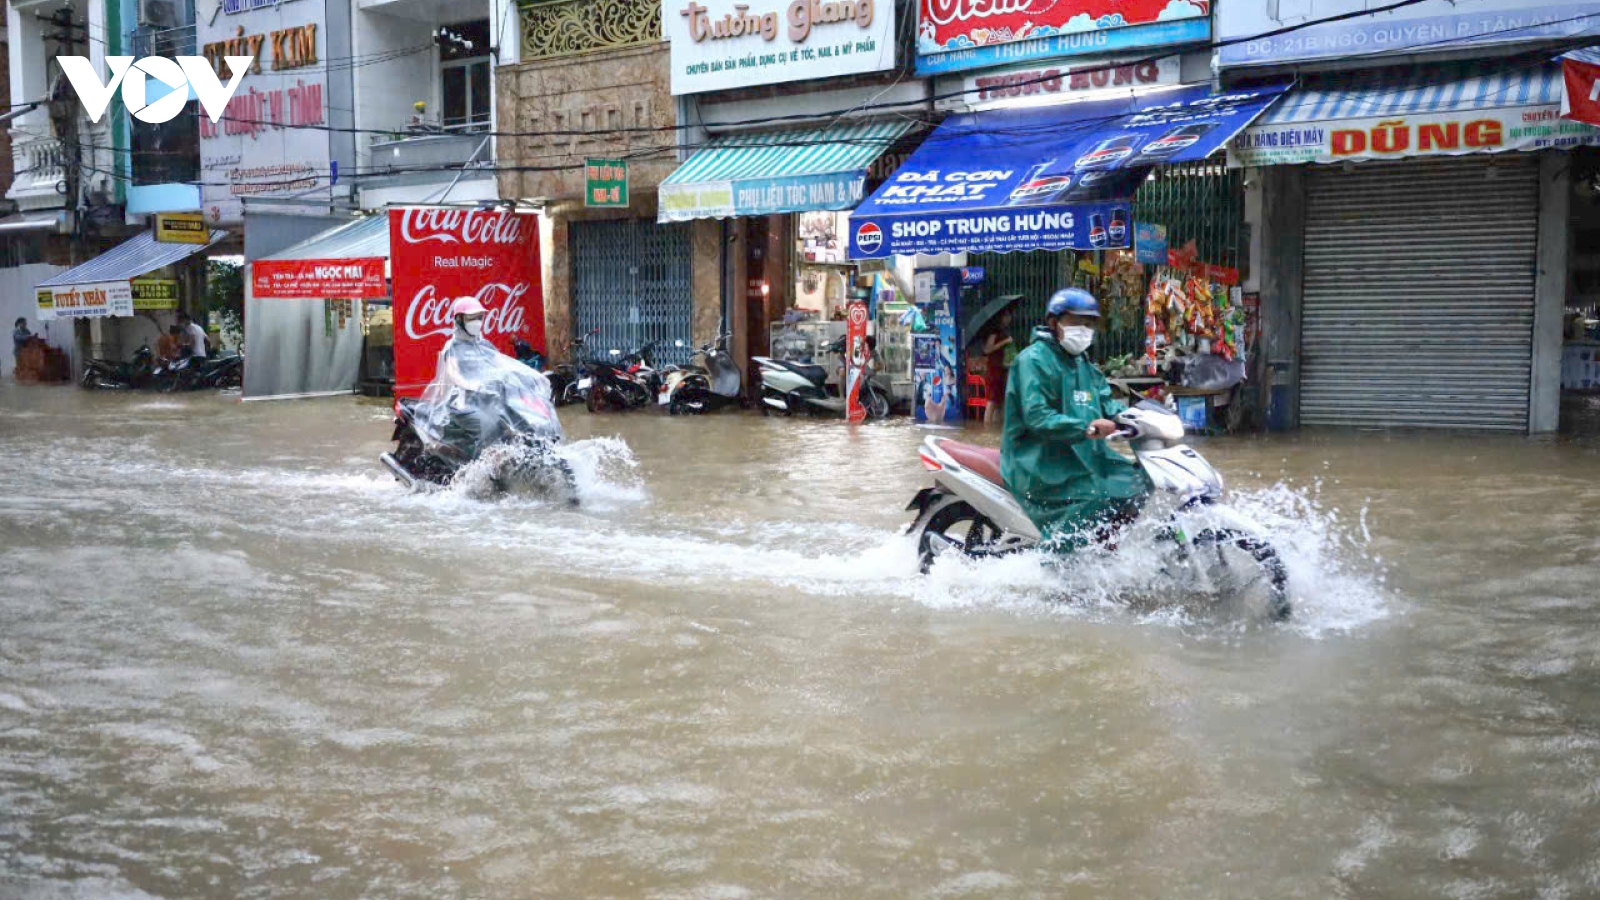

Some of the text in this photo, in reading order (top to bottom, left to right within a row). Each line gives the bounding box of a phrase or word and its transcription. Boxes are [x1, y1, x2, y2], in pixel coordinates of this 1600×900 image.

[270, 23, 318, 71] KIM
[1284, 37, 1318, 51] 21B
[686, 61, 709, 75] CHUYÊN
[976, 69, 1062, 99] TRUNG
[1255, 130, 1278, 146] HÀNG
[1304, 126, 1324, 144] MÁY
[1331, 116, 1504, 156] DŨNG
[809, 182, 835, 205] NAM
[838, 182, 846, 202] &
[882, 182, 998, 197] KHÁT
[891, 211, 1075, 237] SHOP TRUNG HƯNG
[858, 233, 881, 241] PEPSI
[435, 256, 493, 268] Real Magic
[315, 266, 342, 281] NGỌC
[344, 265, 363, 279] MAI
[55, 286, 80, 307] TUYẾT
